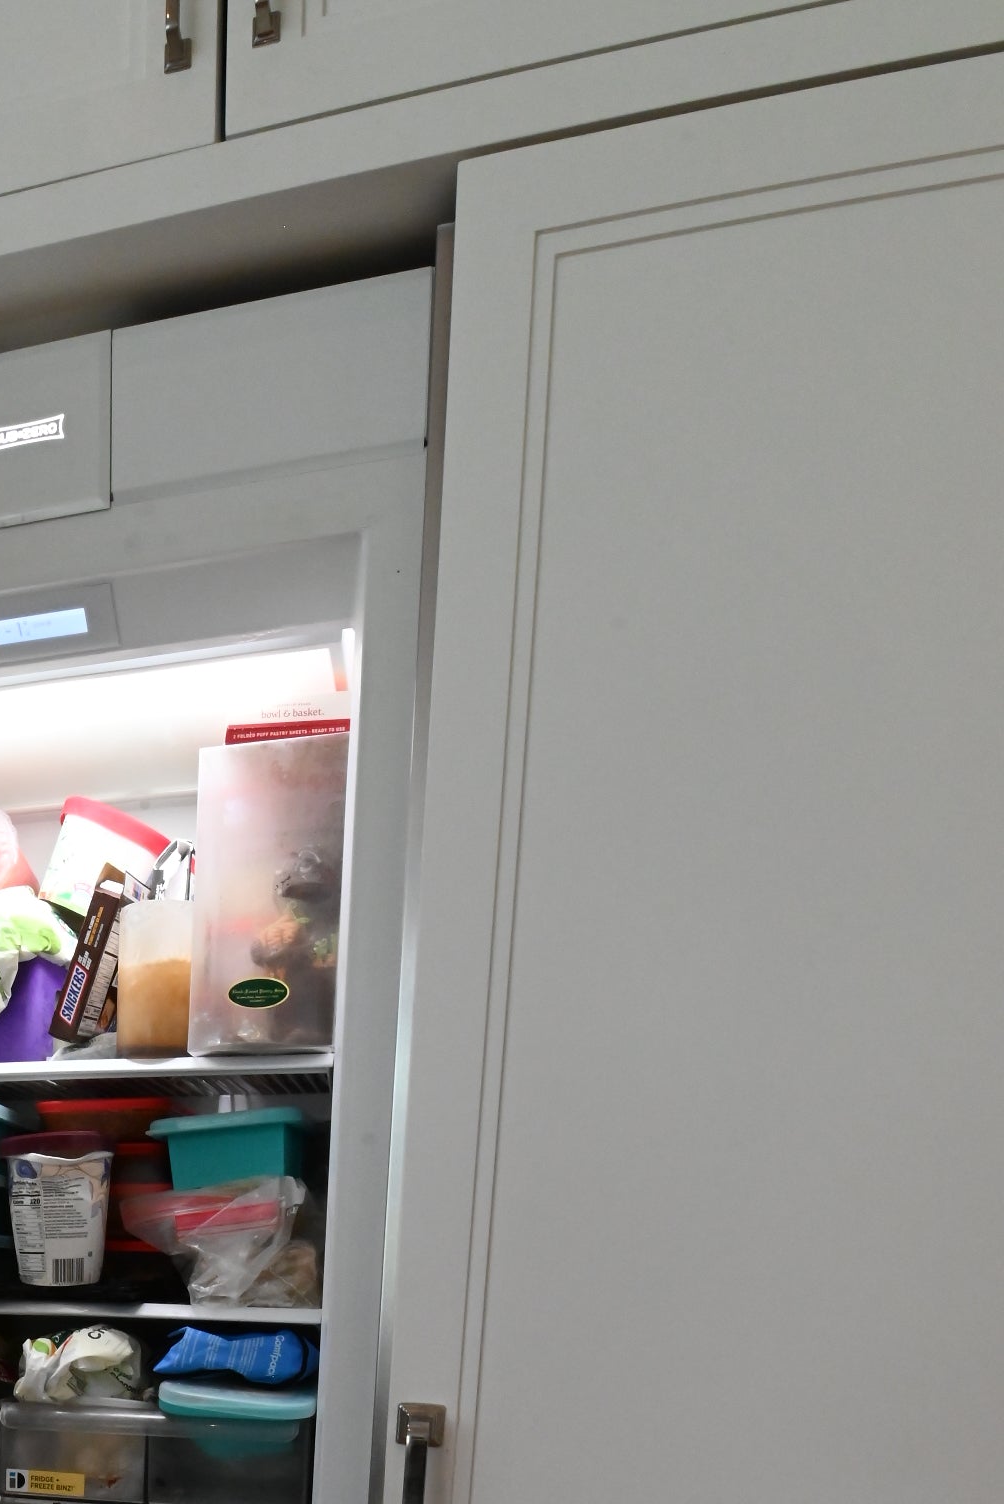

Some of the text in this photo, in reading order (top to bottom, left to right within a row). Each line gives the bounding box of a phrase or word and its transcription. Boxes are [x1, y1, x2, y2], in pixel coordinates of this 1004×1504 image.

[61, 967, 87, 1022] SNICKERS
[30, 1475, 54, 1483] FRIDGE
[30, 1482, 54, 1491] FREEZE
